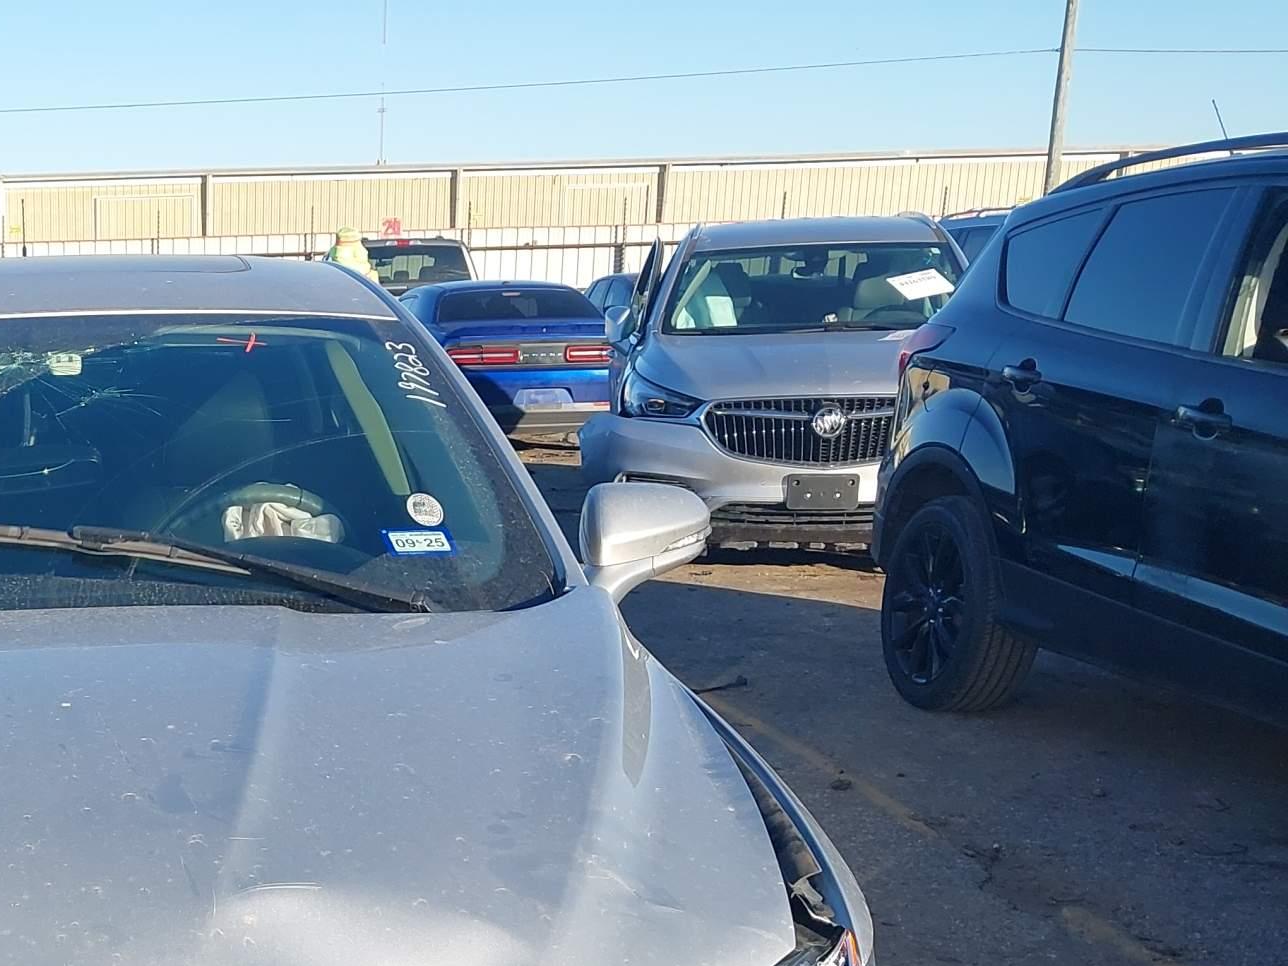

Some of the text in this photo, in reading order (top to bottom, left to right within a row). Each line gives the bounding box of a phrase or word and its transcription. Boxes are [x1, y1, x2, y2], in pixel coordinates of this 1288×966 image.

[384, 341, 447, 408] 197823
[394, 537, 445, 548] 09 25
